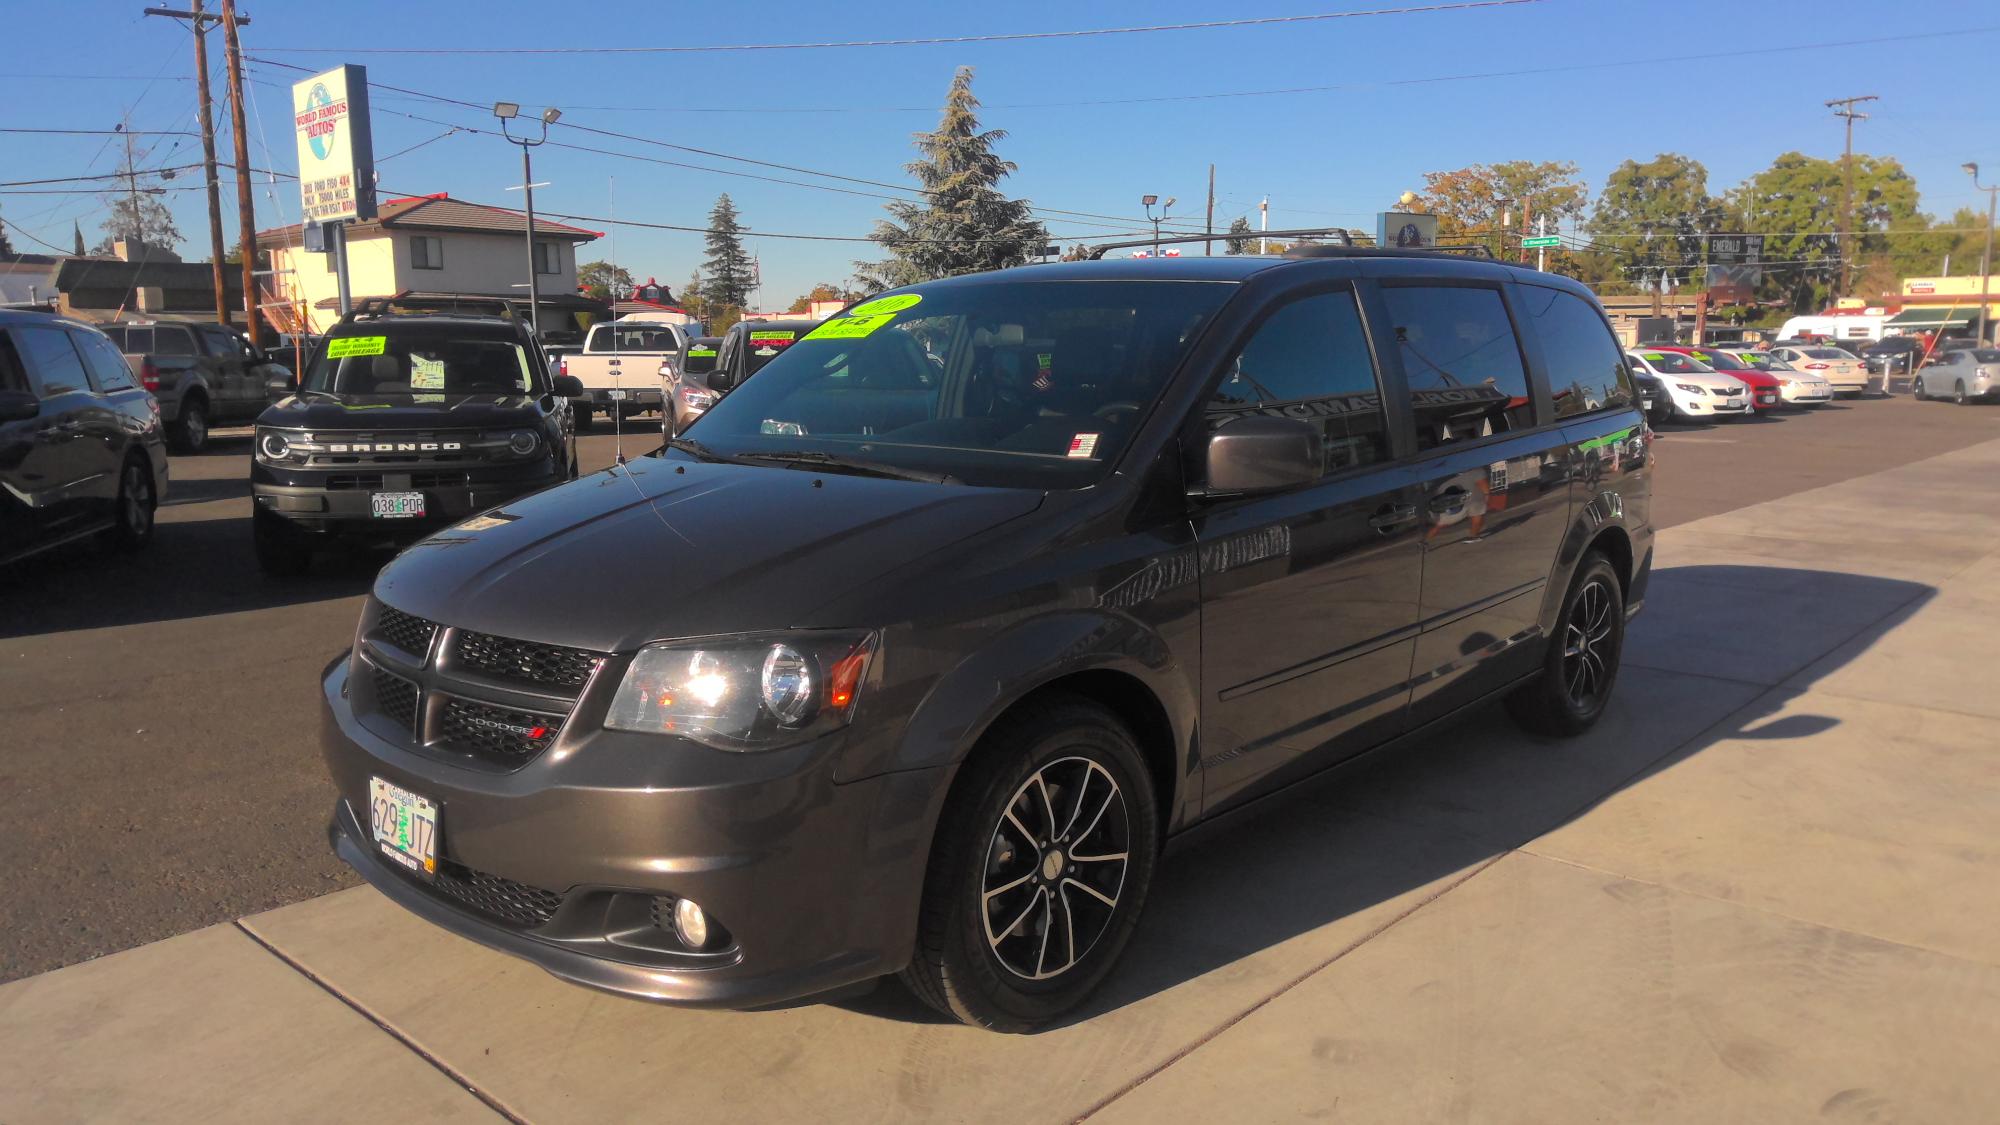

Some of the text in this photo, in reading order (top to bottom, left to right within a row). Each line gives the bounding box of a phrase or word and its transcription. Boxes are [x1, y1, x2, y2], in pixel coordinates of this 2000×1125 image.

[297, 102, 347, 127] WORLD FAMOUS
[339, 175, 351, 187] 4X4
[334, 188, 350, 200] MILES
[1712, 239, 1741, 253] EMERALD
[330, 443, 461, 452] BRONCO
[373, 498, 424, 513] 038 PDR
[475, 718, 535, 735] DODGE
[372, 796, 398, 837] 629
[406, 812, 434, 859] JTZ
